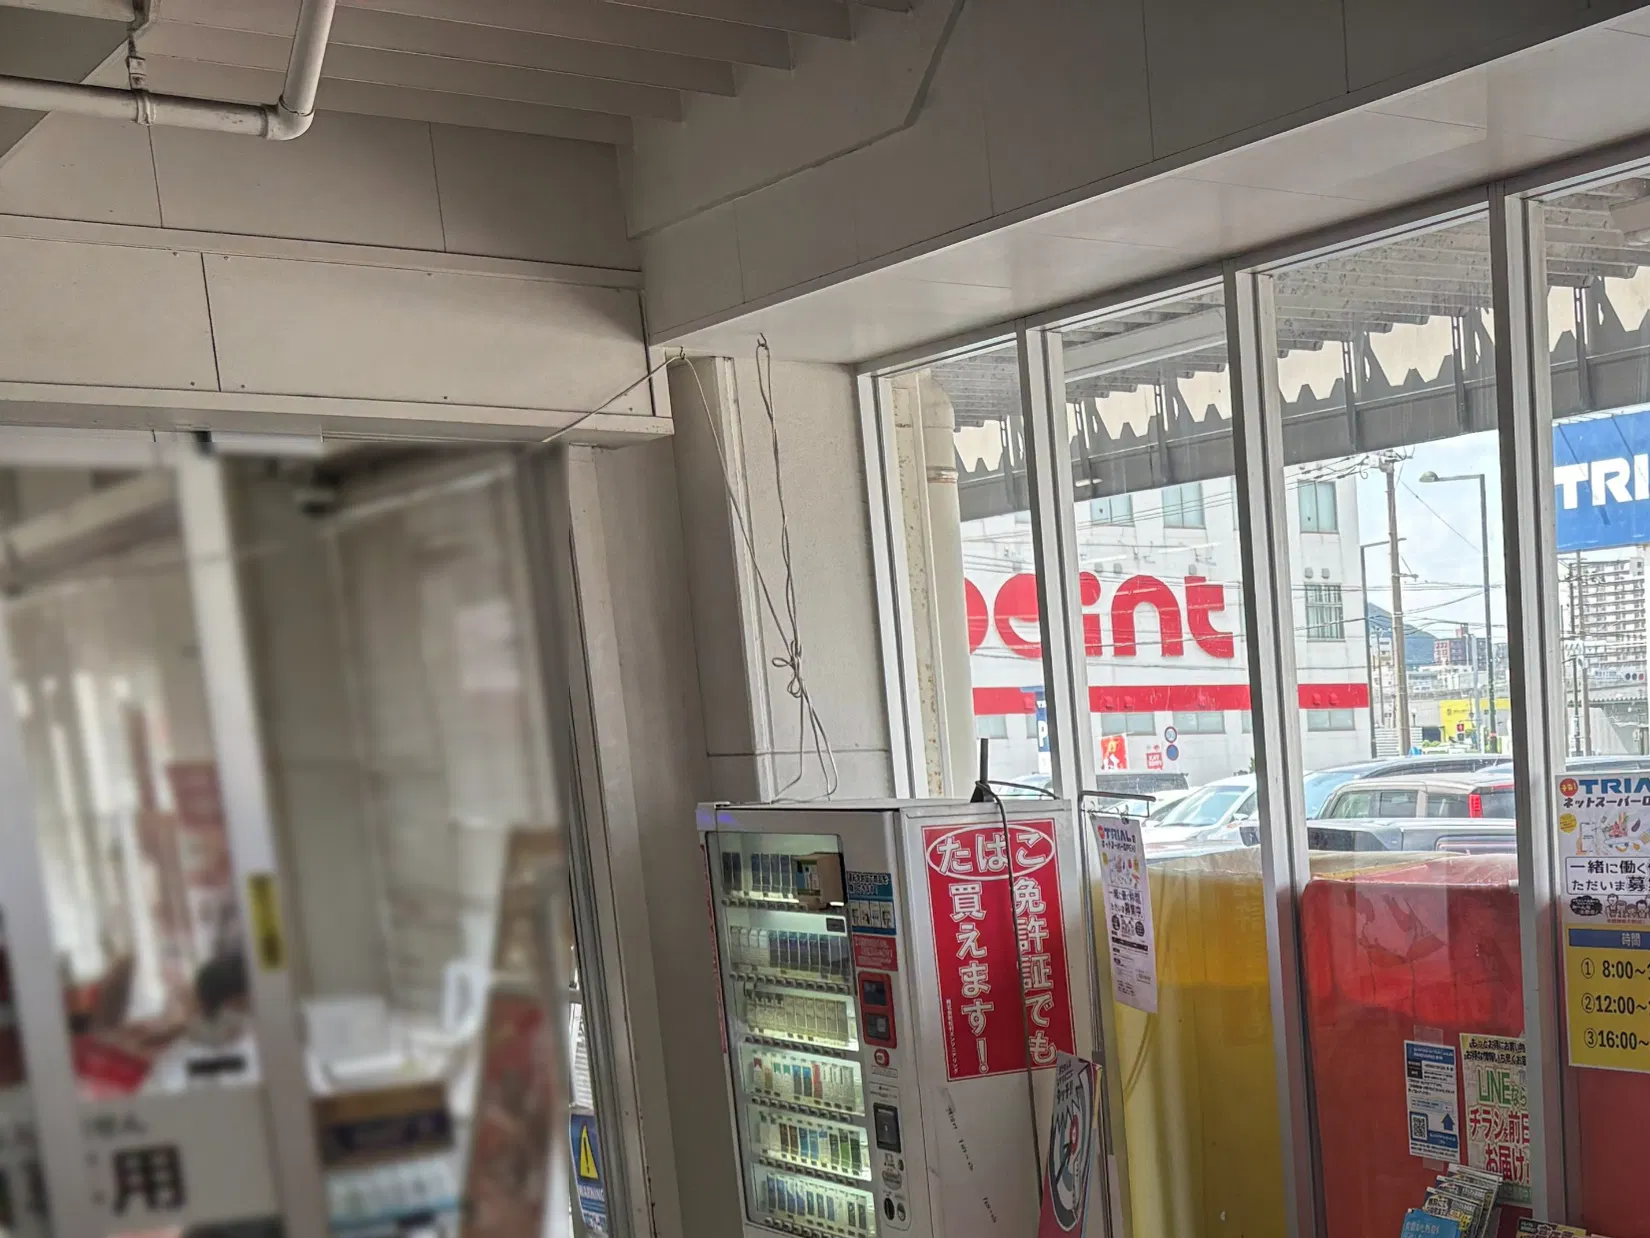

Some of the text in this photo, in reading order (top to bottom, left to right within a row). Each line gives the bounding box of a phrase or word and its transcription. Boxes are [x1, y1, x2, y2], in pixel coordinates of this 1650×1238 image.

[938, 832, 1046, 877] たばこ
[1621, 932, 1640, 947] 時間
[1013, 876, 1056, 1065] 免許証でも
